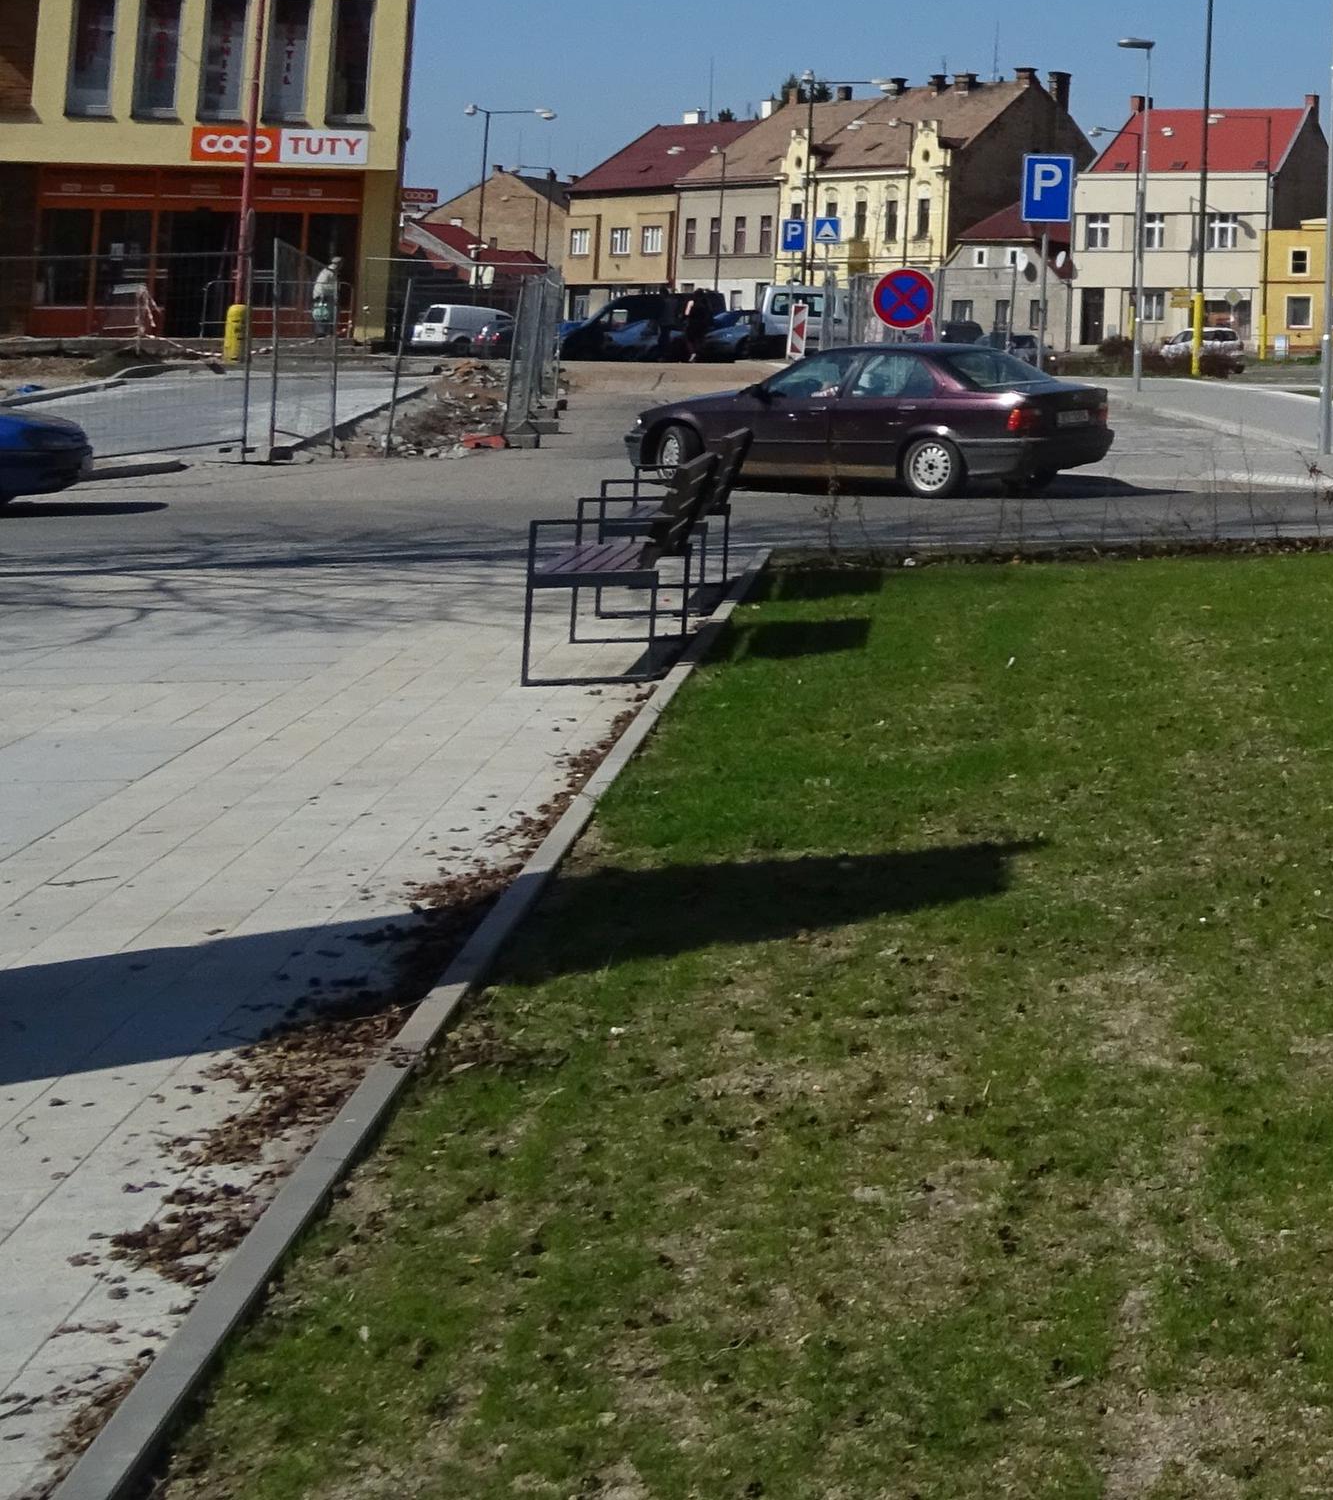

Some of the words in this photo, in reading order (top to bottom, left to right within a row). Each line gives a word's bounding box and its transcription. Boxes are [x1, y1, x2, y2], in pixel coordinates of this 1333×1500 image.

[288, 136, 363, 156] TUTY
[1033, 164, 1063, 201] P
[787, 224, 802, 242] P
